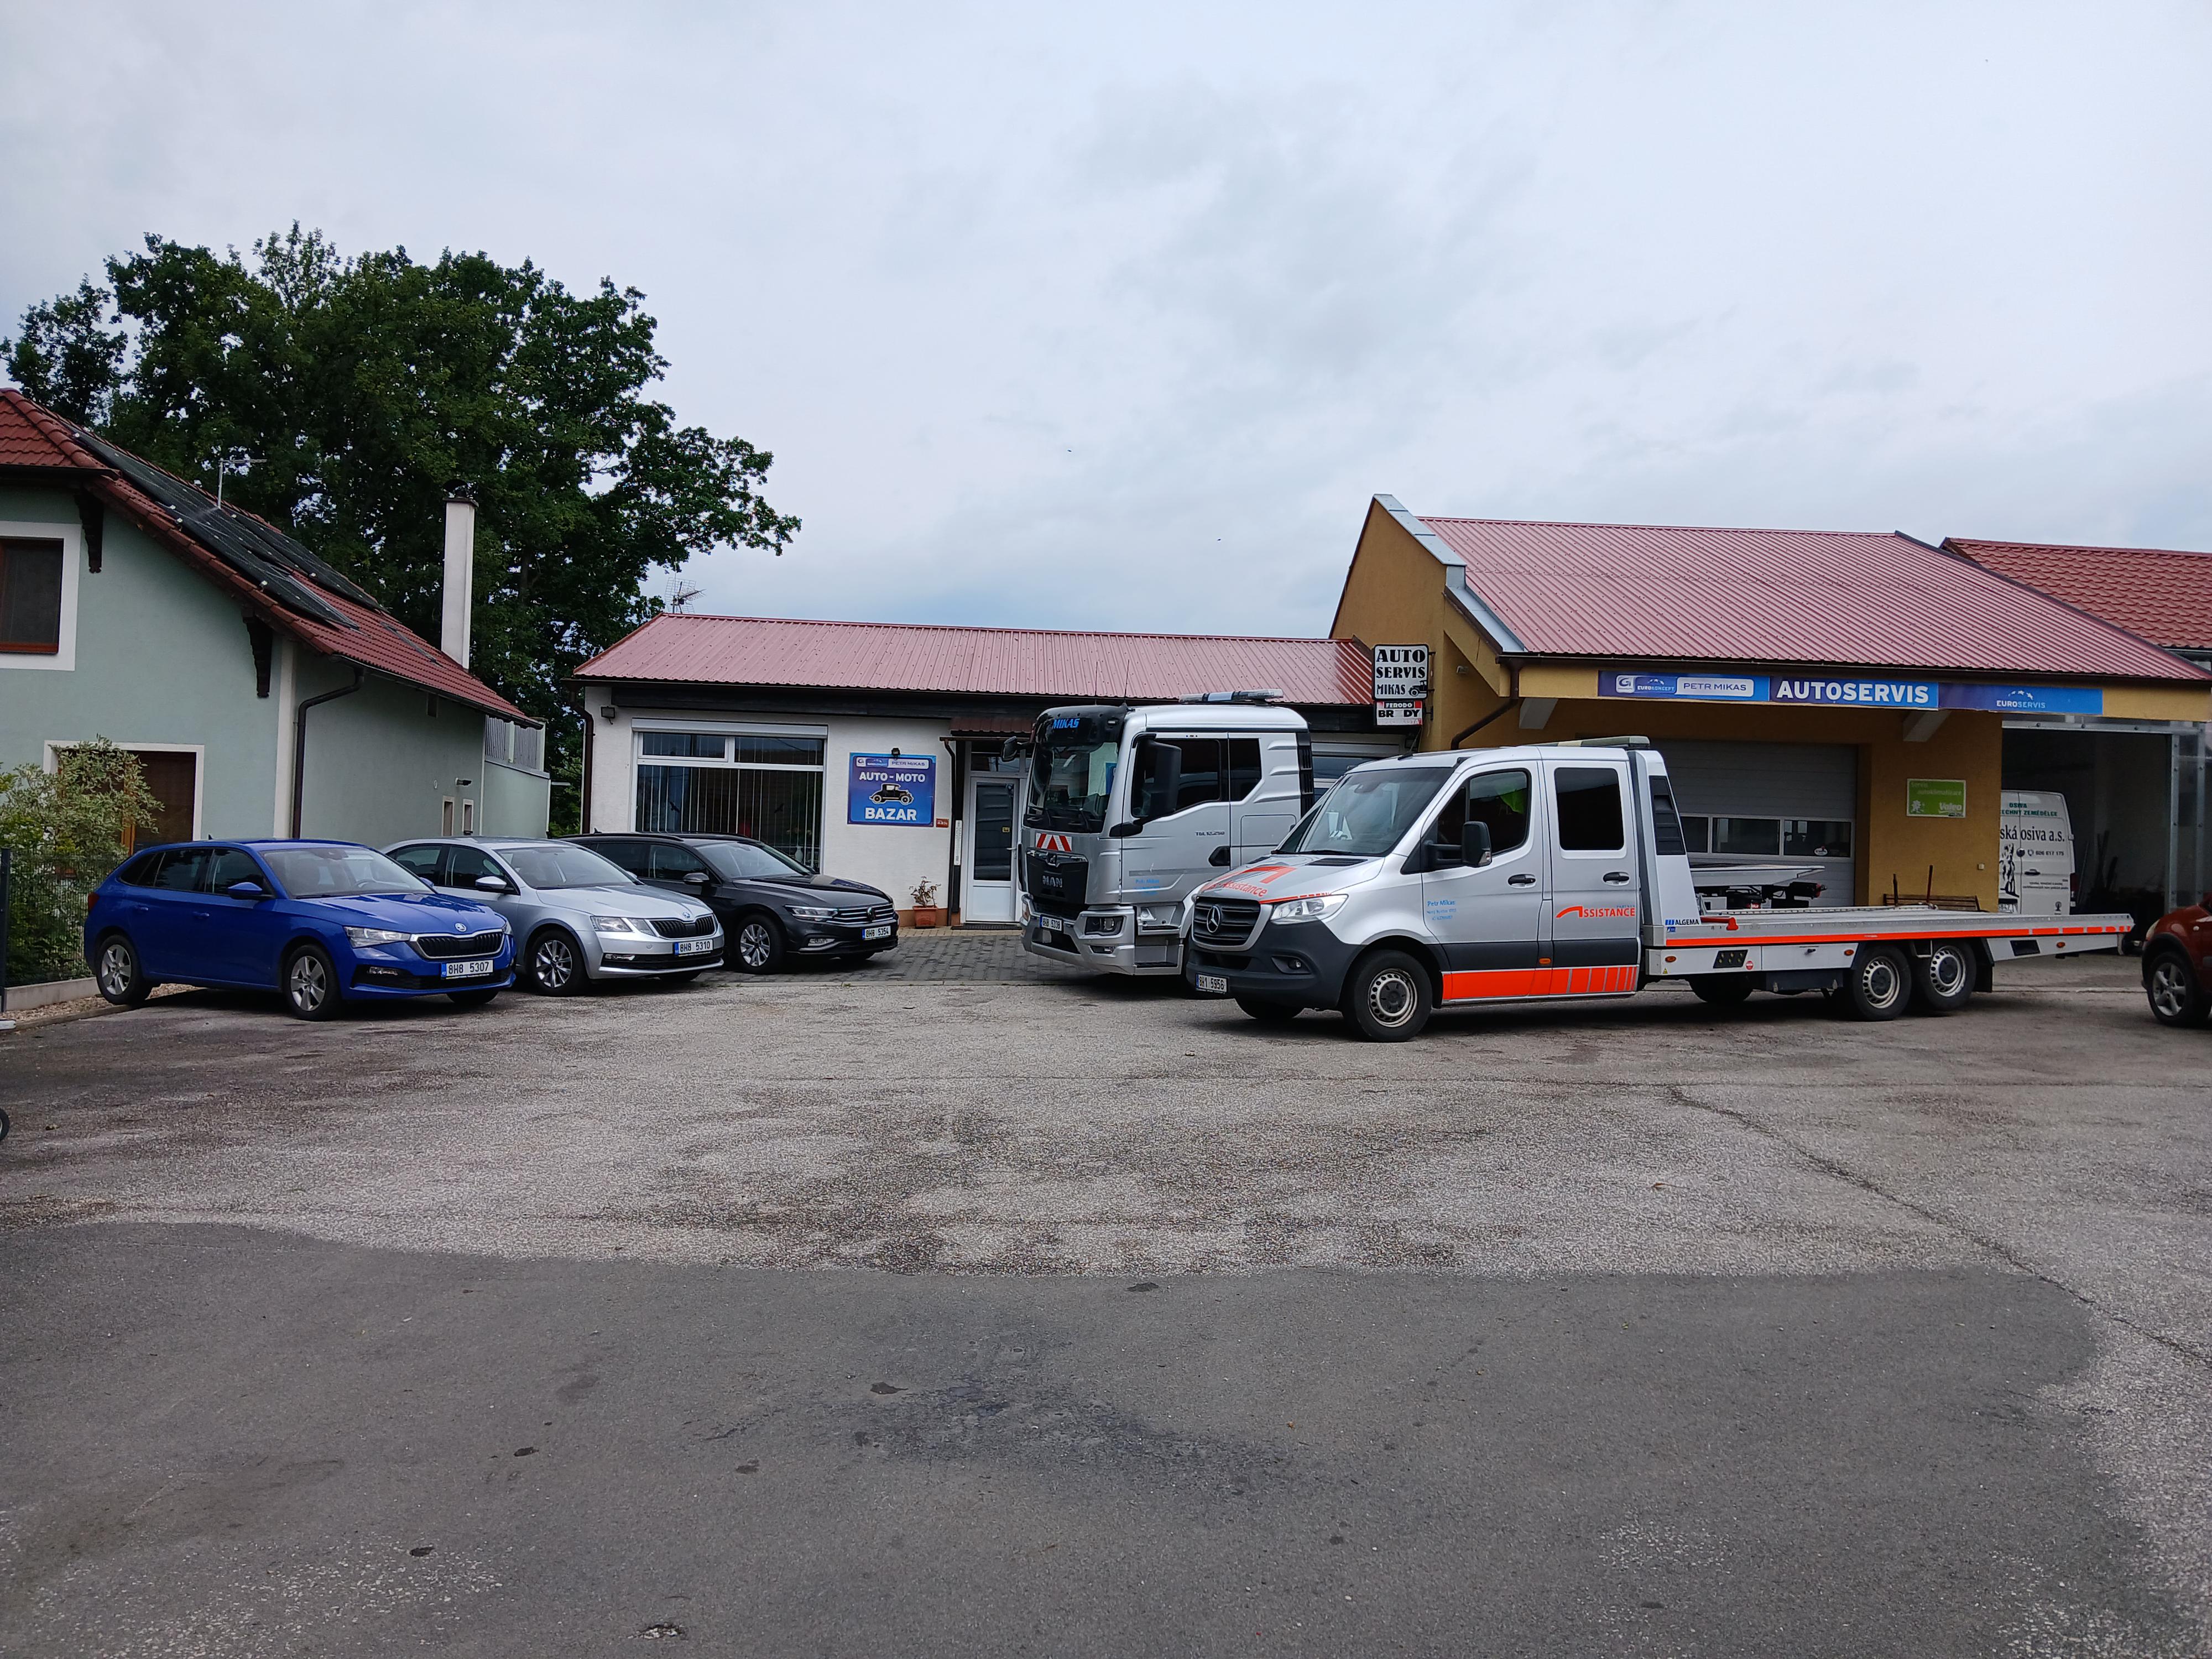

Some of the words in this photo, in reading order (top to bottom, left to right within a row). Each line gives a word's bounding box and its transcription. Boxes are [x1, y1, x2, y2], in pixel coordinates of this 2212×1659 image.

[1376, 649, 1425, 662] AUTO
[1376, 667, 1425, 679] SERVIS
[1377, 684, 1405, 695] MIKAS
[1776, 681, 1929, 703] AUTOSERVIS
[1996, 700, 2046, 708] EUROSERVIS
[1052, 718, 1080, 729] MIKAS
[859, 772, 888, 781] AUTO
[895, 773, 926, 782] MOTO
[865, 807, 917, 821] BAZAR
[2021, 826, 2046, 841] osiva
[2049, 831, 2065, 842] a.s.
[1042, 875, 1062, 888] MAN
[680, 943, 691, 952] 8H8
[696, 941, 710, 950] 5310
[448, 964, 463, 974] 8H8
[469, 962, 489, 972] 5307
[1211, 978, 1224, 990] 5956
